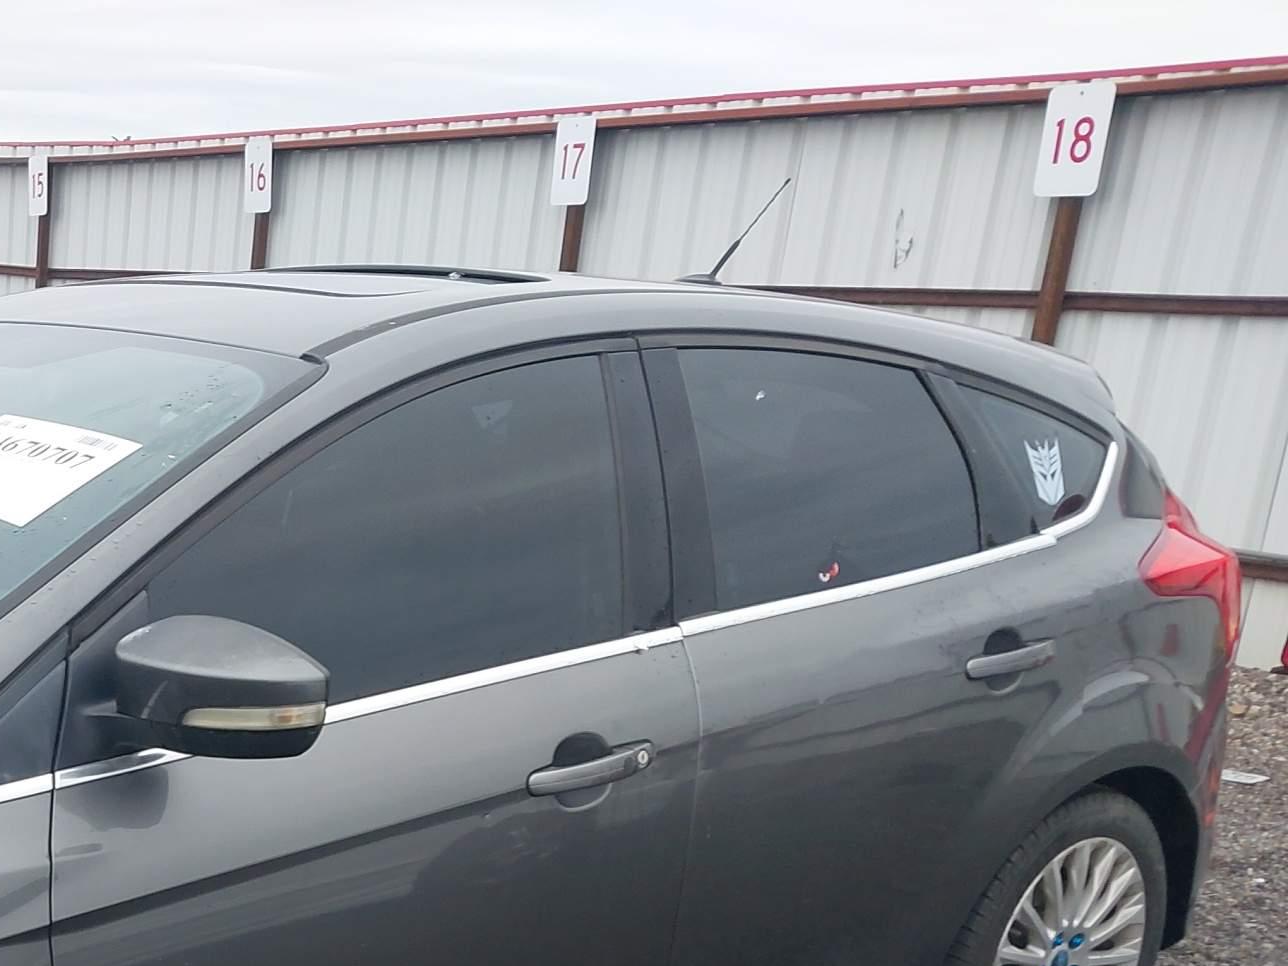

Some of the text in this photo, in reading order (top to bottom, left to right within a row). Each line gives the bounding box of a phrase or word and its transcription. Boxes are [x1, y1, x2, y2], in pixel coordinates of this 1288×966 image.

[1052, 116, 1094, 165] 18
[250, 163, 266, 192] 16
[561, 143, 585, 180] 17
[32, 173, 43, 198] 15
